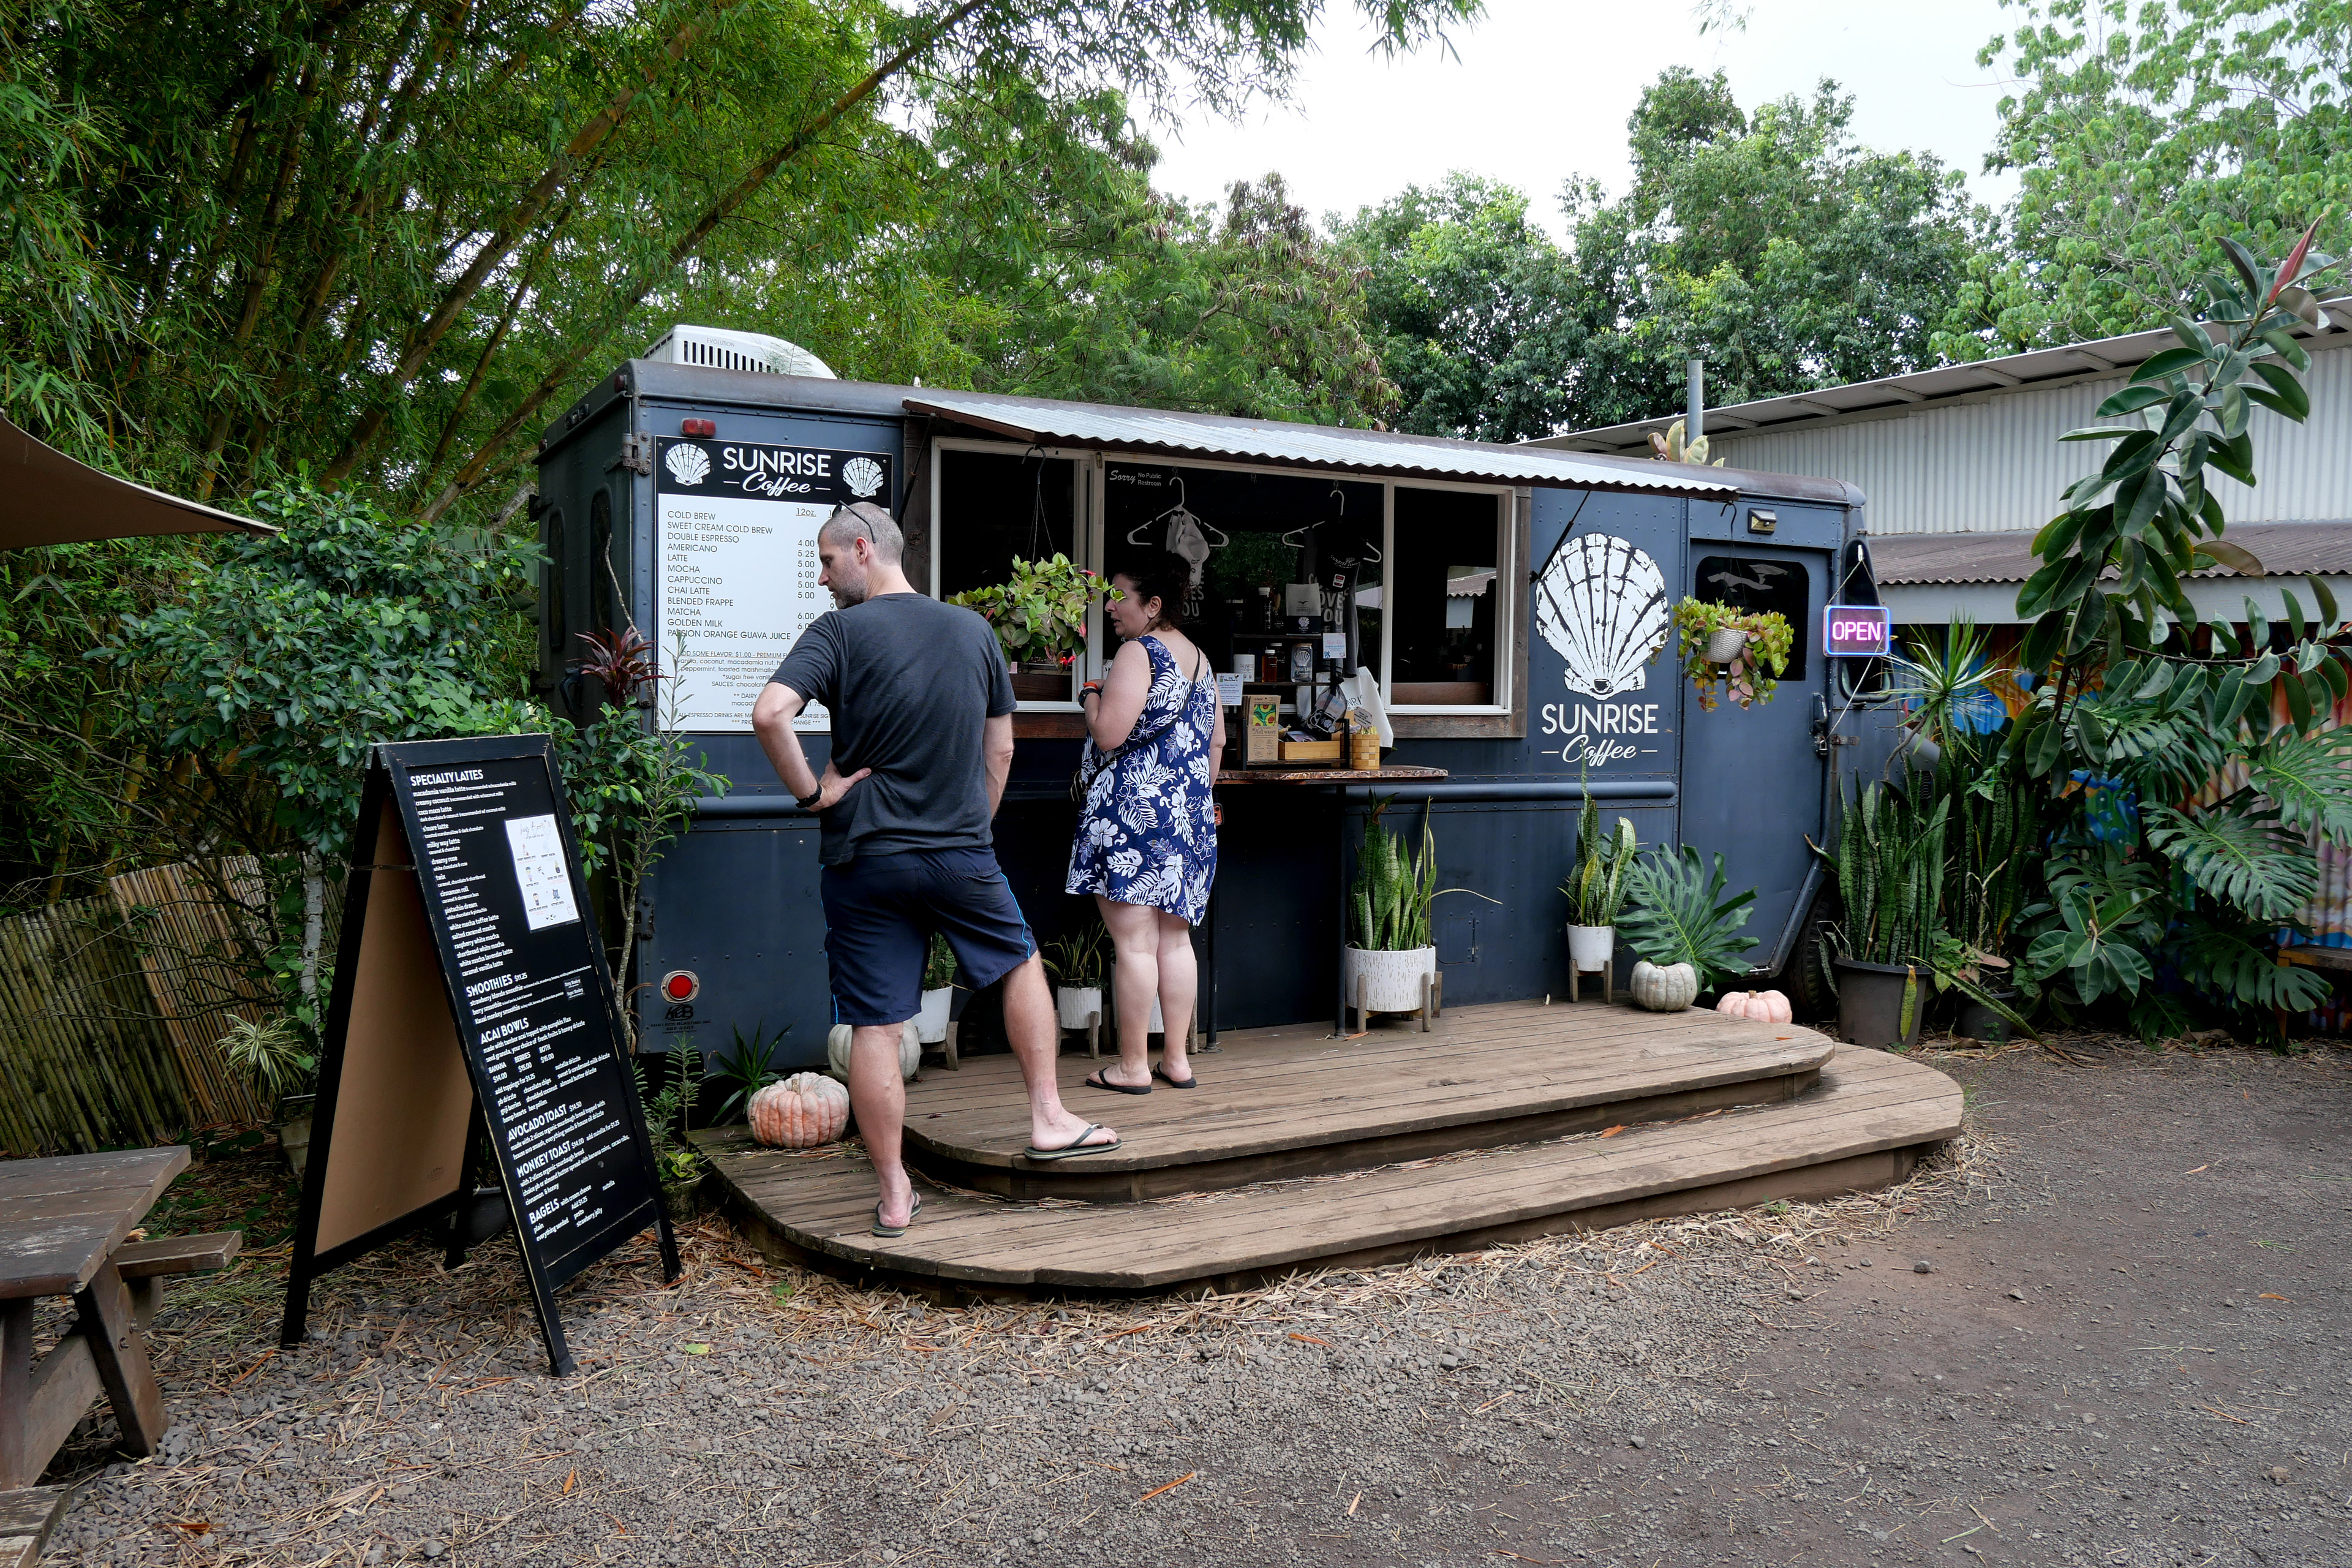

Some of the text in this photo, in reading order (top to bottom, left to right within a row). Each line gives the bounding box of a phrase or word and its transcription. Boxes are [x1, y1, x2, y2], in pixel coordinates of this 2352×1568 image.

[723, 447, 831, 477] SUNRISE
[1109, 470, 1136, 484] Sorry
[742, 472, 811, 497] Coffee
[668, 510, 692, 519] COLD
[668, 521, 773, 535] SWEET CREAM COLD BREW
[668, 532, 740, 543] DOUBLE ESPRESSO
[667, 543, 718, 552] AMERICANO
[668, 575, 723, 585] CAPPUCCINO
[668, 597, 734, 607] BLENDED FRAPPE
[668, 608, 701, 616] MATCHA
[668, 618, 723, 628] GOLDEN MILK
[668, 629, 791, 641] PASION ORANGE GUAVA JUICE
[1832, 621, 1881, 641] OPEN
[1541, 703, 1659, 734] SUNRISE
[1562, 734, 1637, 767] Coffee
[410, 770, 483, 786] SPECIALTY LATTES
[445, 904, 464, 915] pistachio
[465, 927, 482, 936] caramel
[456, 948, 480, 958] shortbread
[484, 952, 503, 960] lavender
[462, 967, 479, 976] caramel
[466, 974, 513, 997] SMOOTHIES
[470, 995, 492, 1006] strawberry
[491, 990, 505, 999] blonde
[505, 985, 524, 995] smoothie
[483, 1001, 502, 1011] smoothie
[475, 1005, 521, 1024] Kauai monkey smoothie
[481, 1018, 529, 1044] ACAI BOWLS
[548, 1020, 564, 1030] pumpkin
[562, 1021, 586, 1035] honey drizzle
[489, 1045, 551, 1074] BANANA BERRIES BOTH
[493, 1072, 508, 1084] $14.00
[519, 1062, 532, 1073] $15.00
[503, 1080, 521, 1092] toppings
[508, 1115, 545, 1142] AVOCADO
[544, 1104, 568, 1128] TOAST
[517, 1150, 550, 1178] MONKEY
[548, 1140, 571, 1162] TOAST
[526, 1184, 559, 1206] cinnamon honey
[529, 1199, 560, 1224] BAGELS
[533, 1210, 585, 1234] plain pesto
[537, 1226, 557, 1242] everything
[576, 1214, 596, 1227] strawberry
